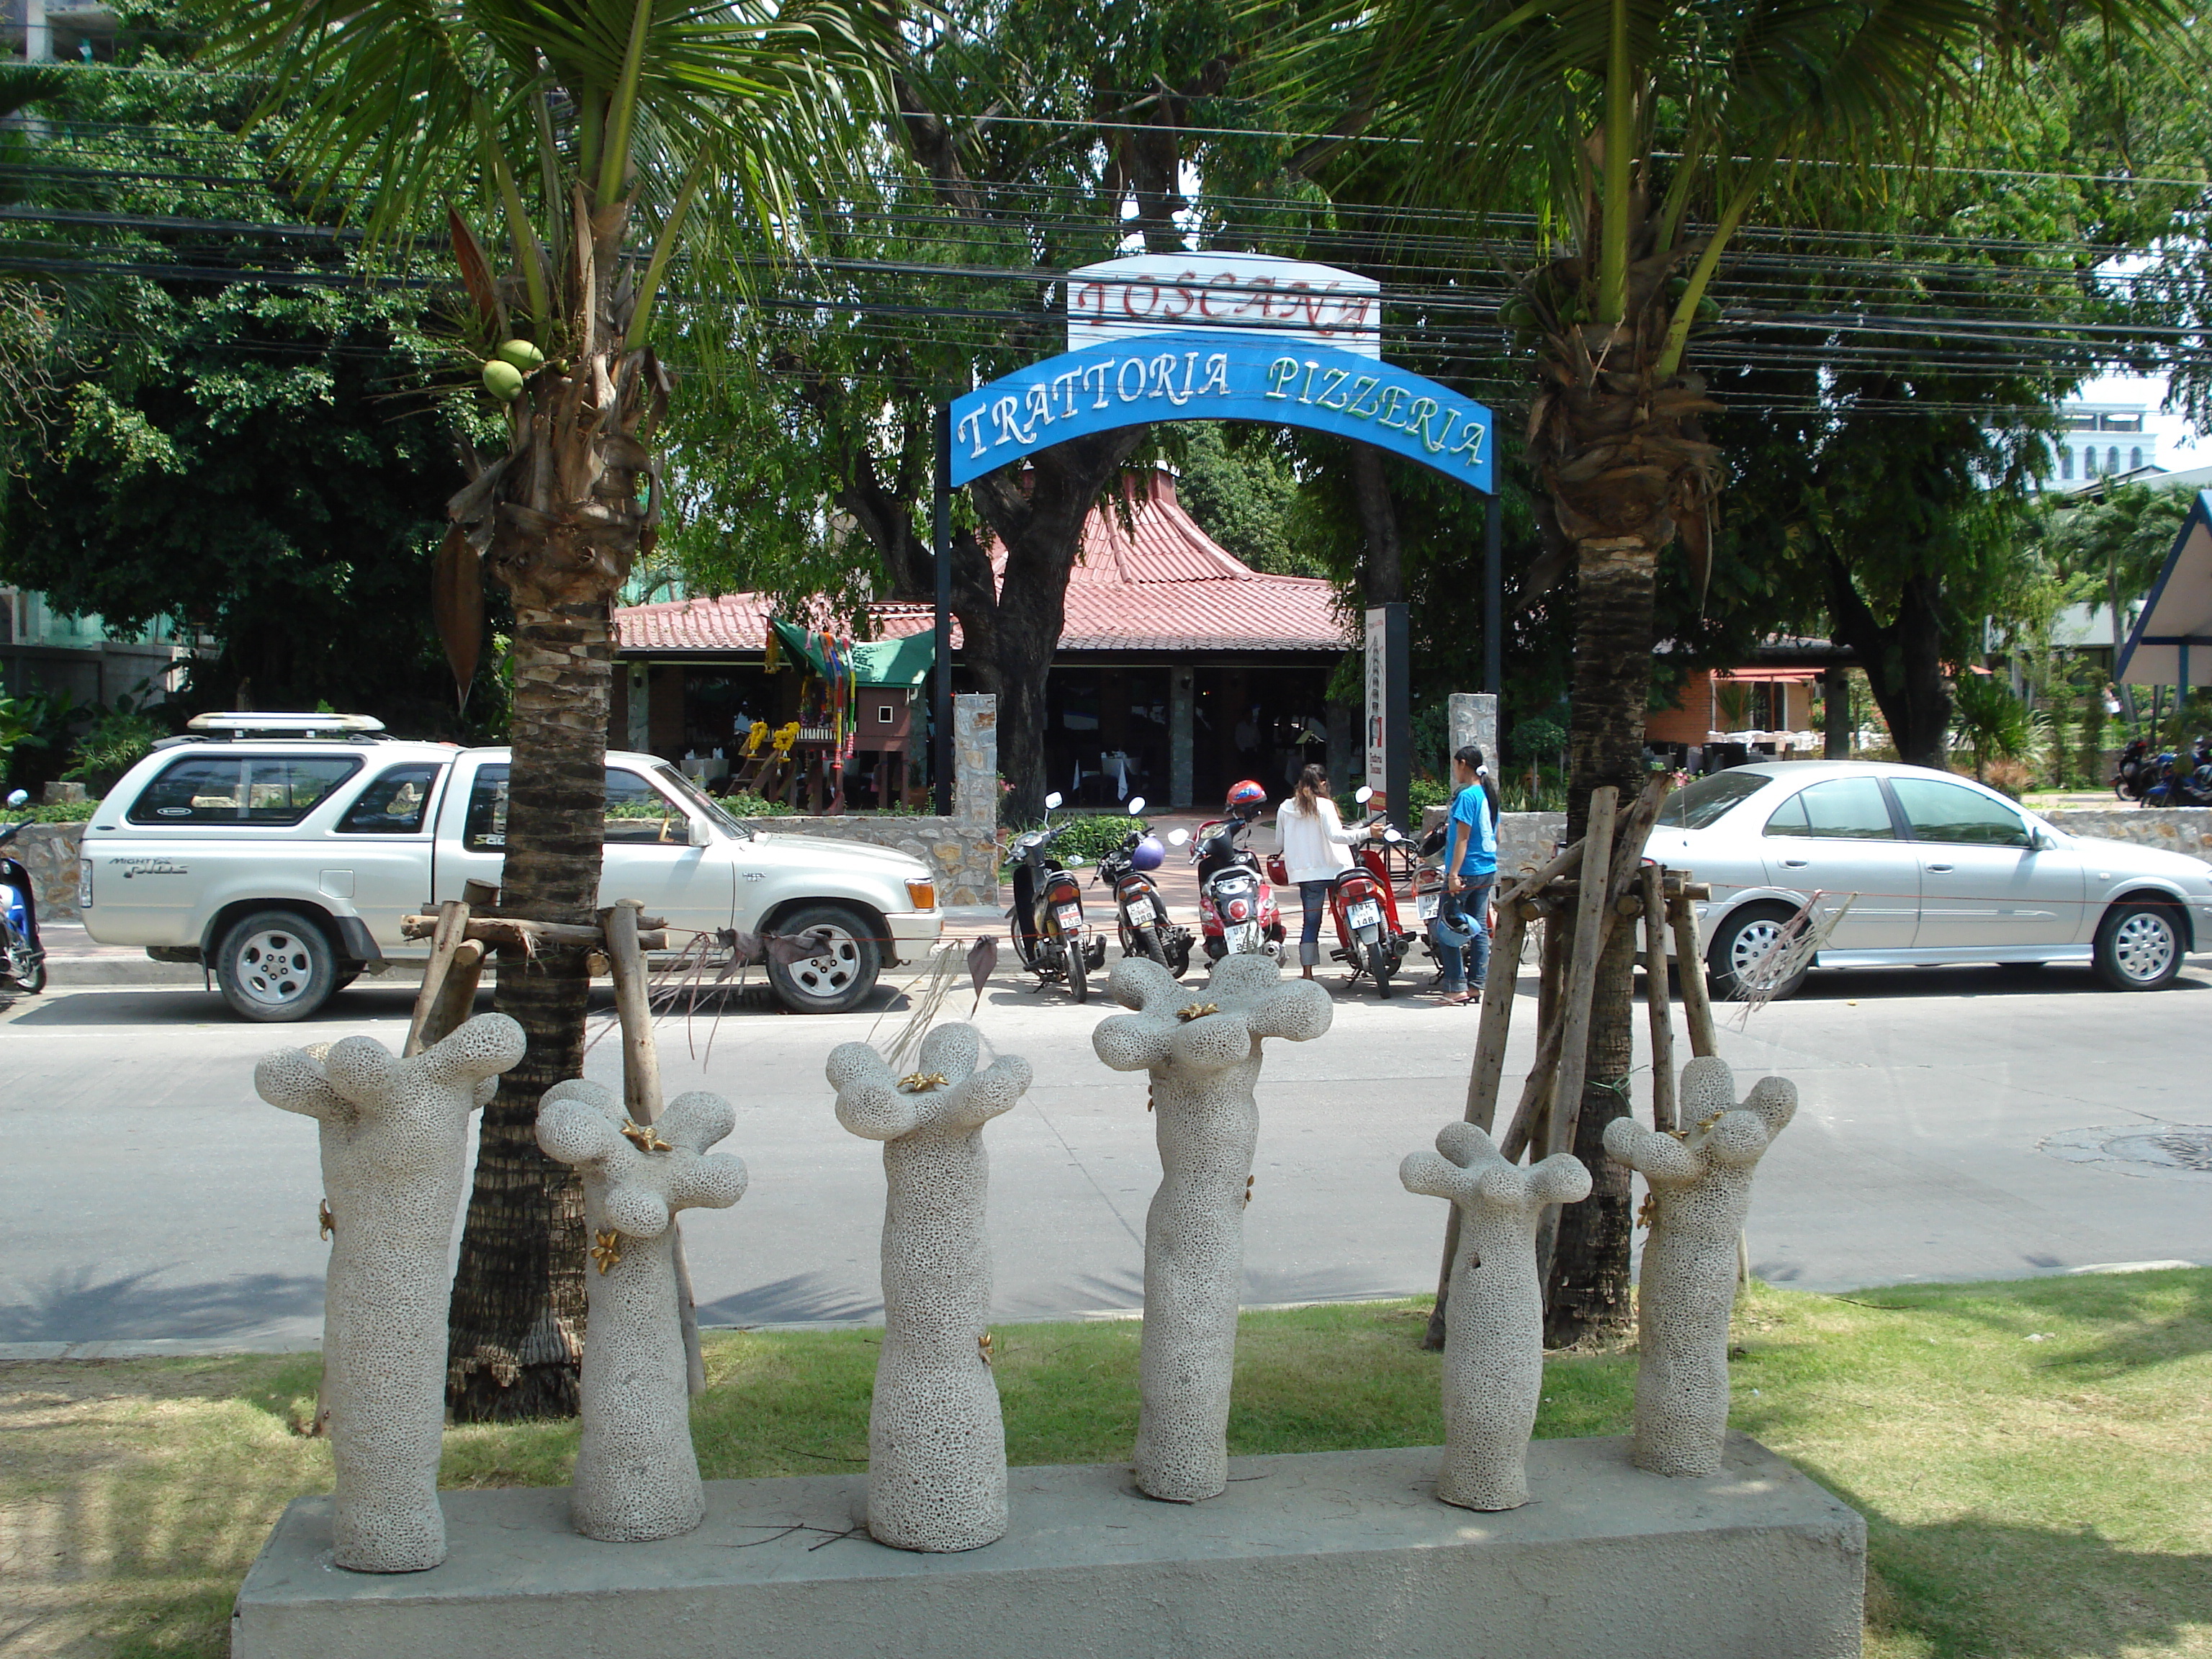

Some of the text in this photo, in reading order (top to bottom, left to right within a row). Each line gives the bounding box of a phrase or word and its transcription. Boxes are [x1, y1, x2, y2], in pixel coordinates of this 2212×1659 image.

[1077, 271, 1371, 337] TOSCANA
[957, 351, 1486, 467] TRATTORIA PIZZERIA
[1357, 917, 1374, 927] 148
